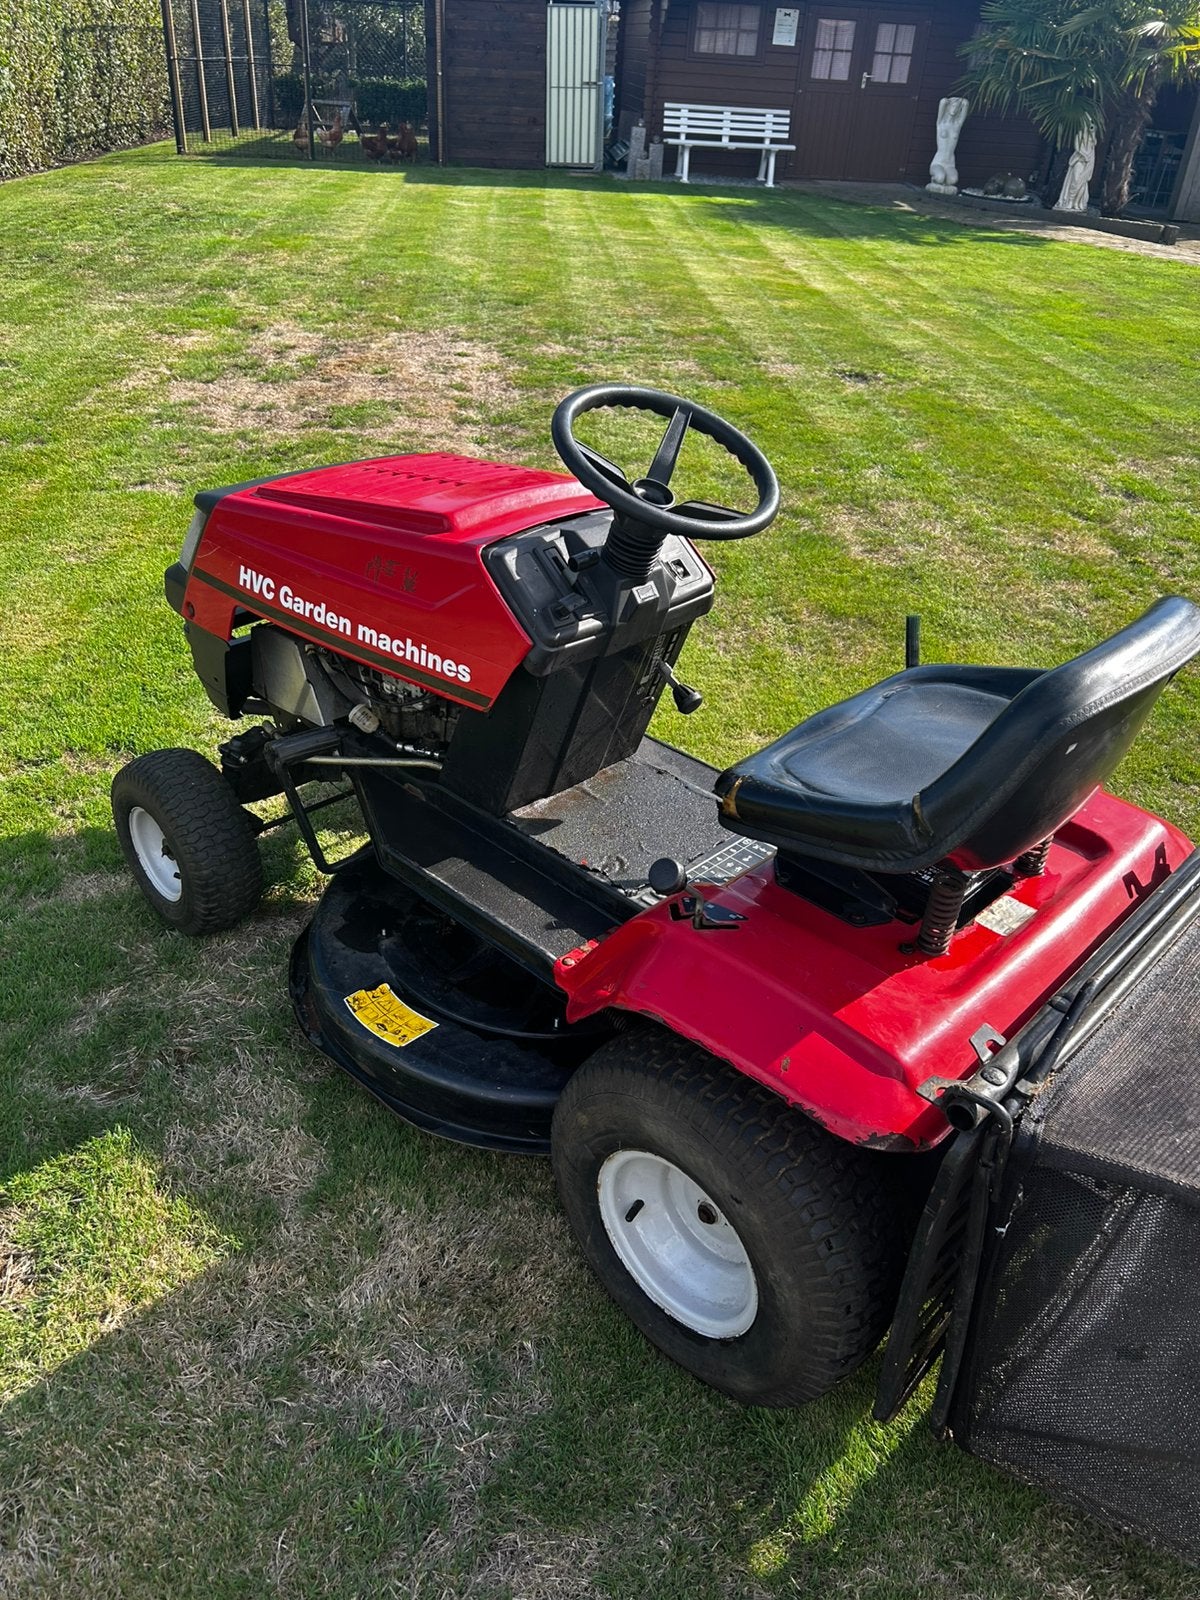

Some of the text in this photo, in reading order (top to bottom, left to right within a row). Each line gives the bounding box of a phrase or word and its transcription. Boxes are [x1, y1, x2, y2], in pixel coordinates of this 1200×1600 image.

[239, 565, 472, 683] HVC Garden machines
